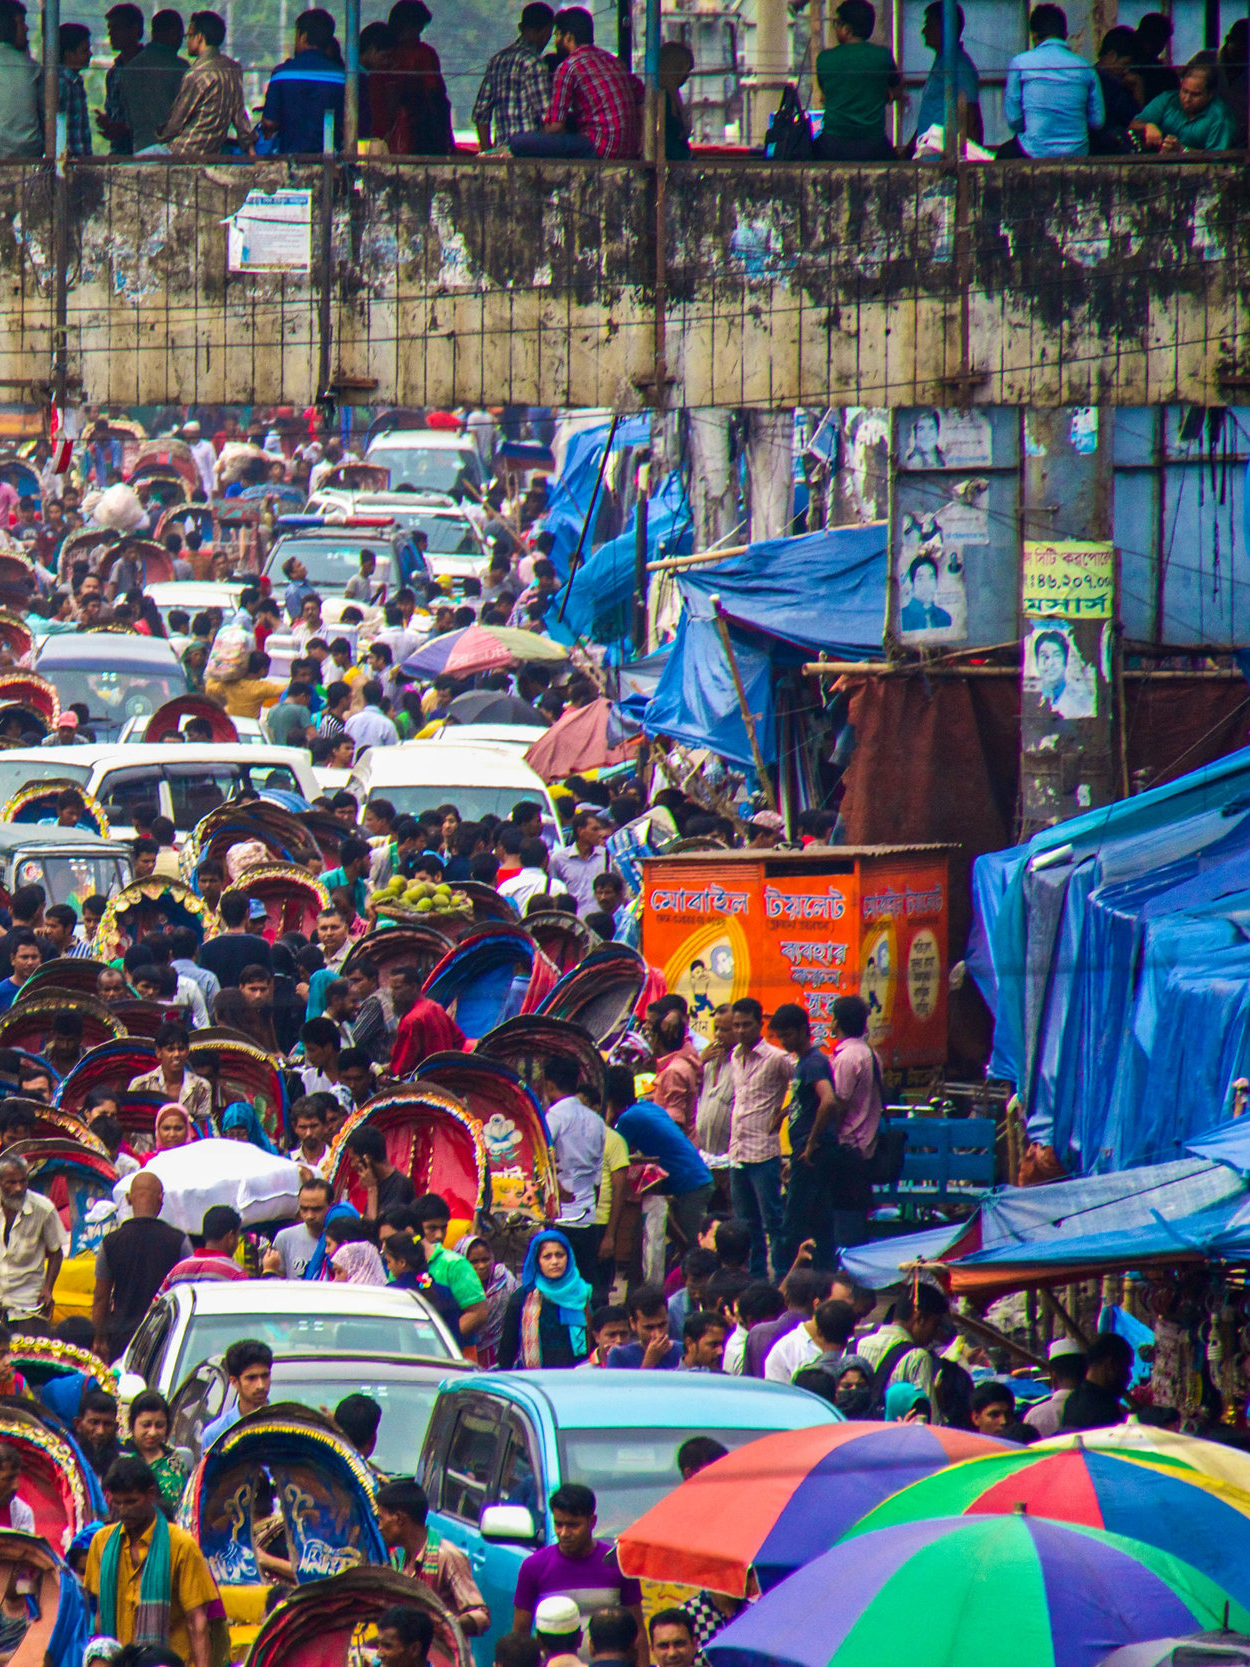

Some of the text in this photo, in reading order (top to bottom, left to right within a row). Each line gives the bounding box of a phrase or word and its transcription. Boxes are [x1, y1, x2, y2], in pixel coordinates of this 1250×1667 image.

[650, 883, 846, 920] মোবাইল টয়লেট
[780, 940, 849, 968] ব্যবহার
